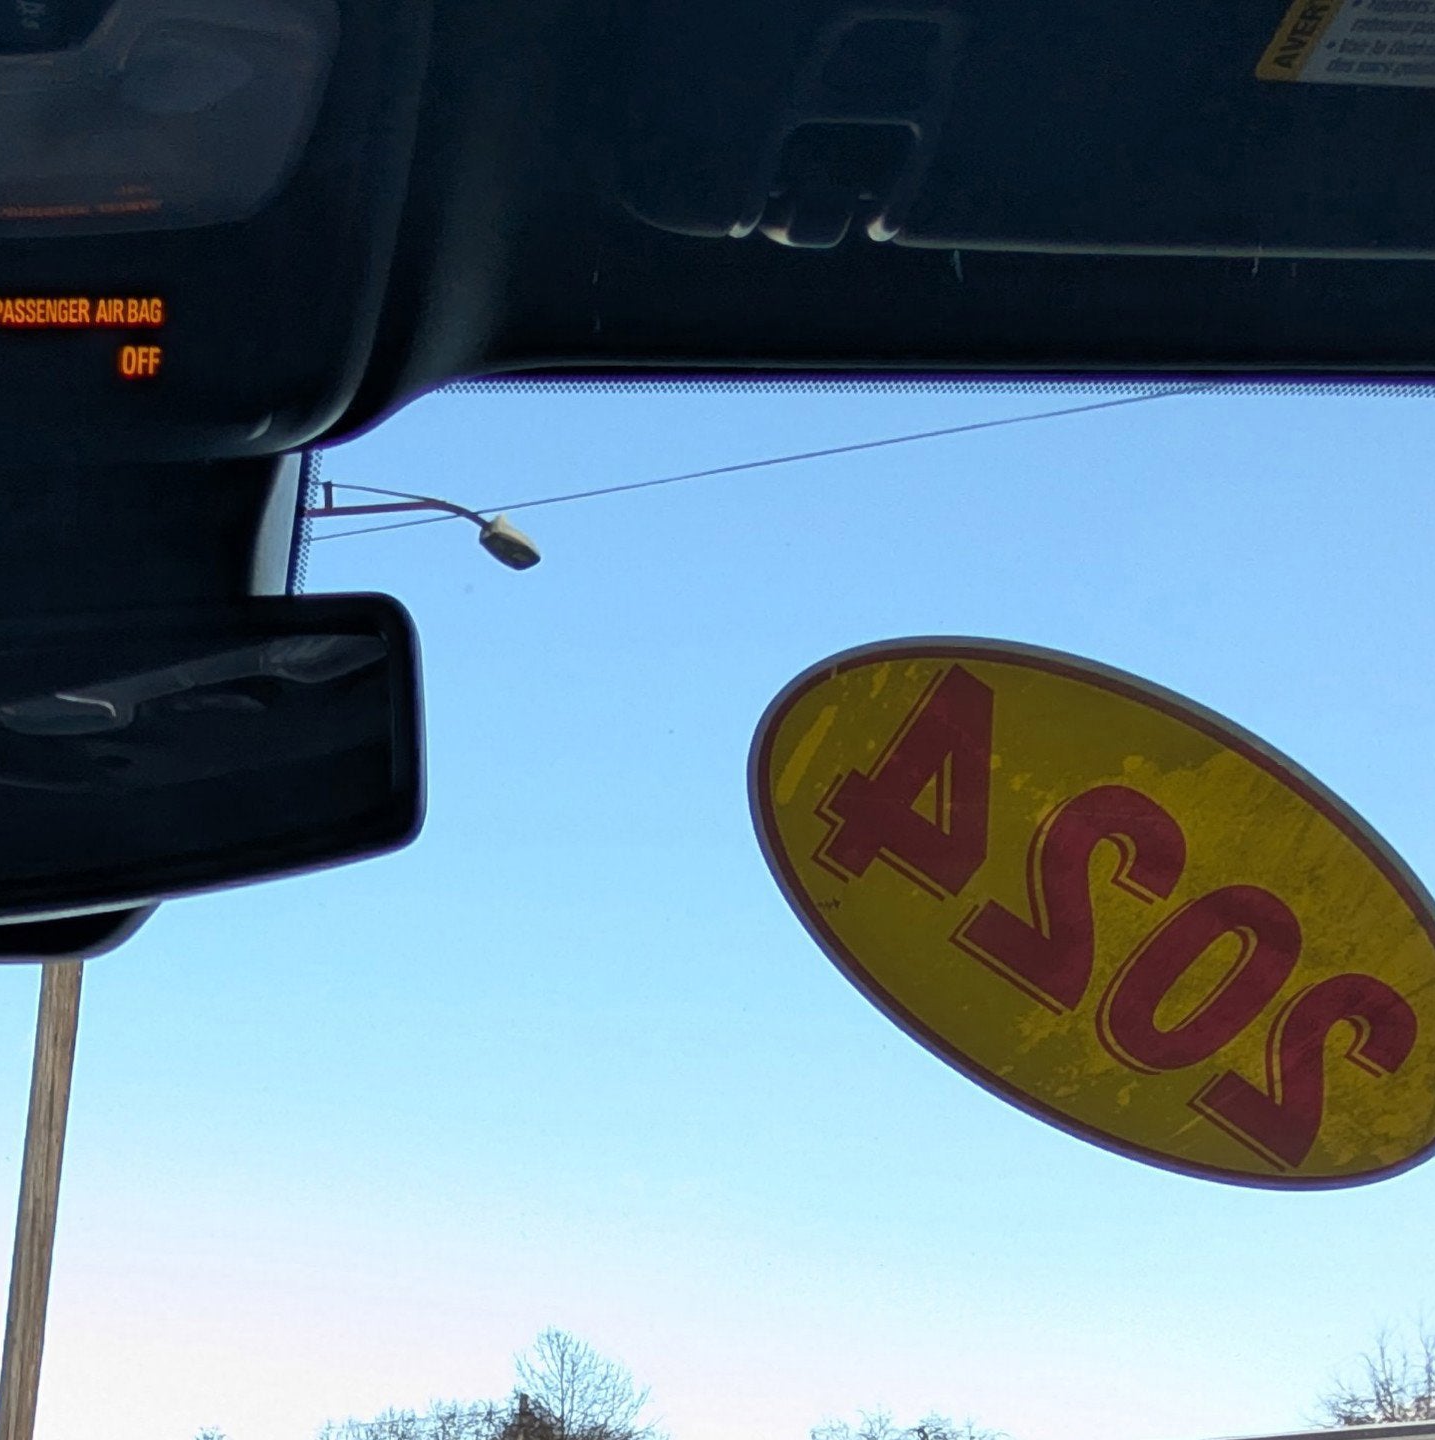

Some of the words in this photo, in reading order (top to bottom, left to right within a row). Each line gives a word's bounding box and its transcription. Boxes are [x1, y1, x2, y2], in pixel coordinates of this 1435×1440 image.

[96, 298, 124, 323] AIR
[127, 298, 162, 323] BAG
[122, 346, 161, 375] OFF
